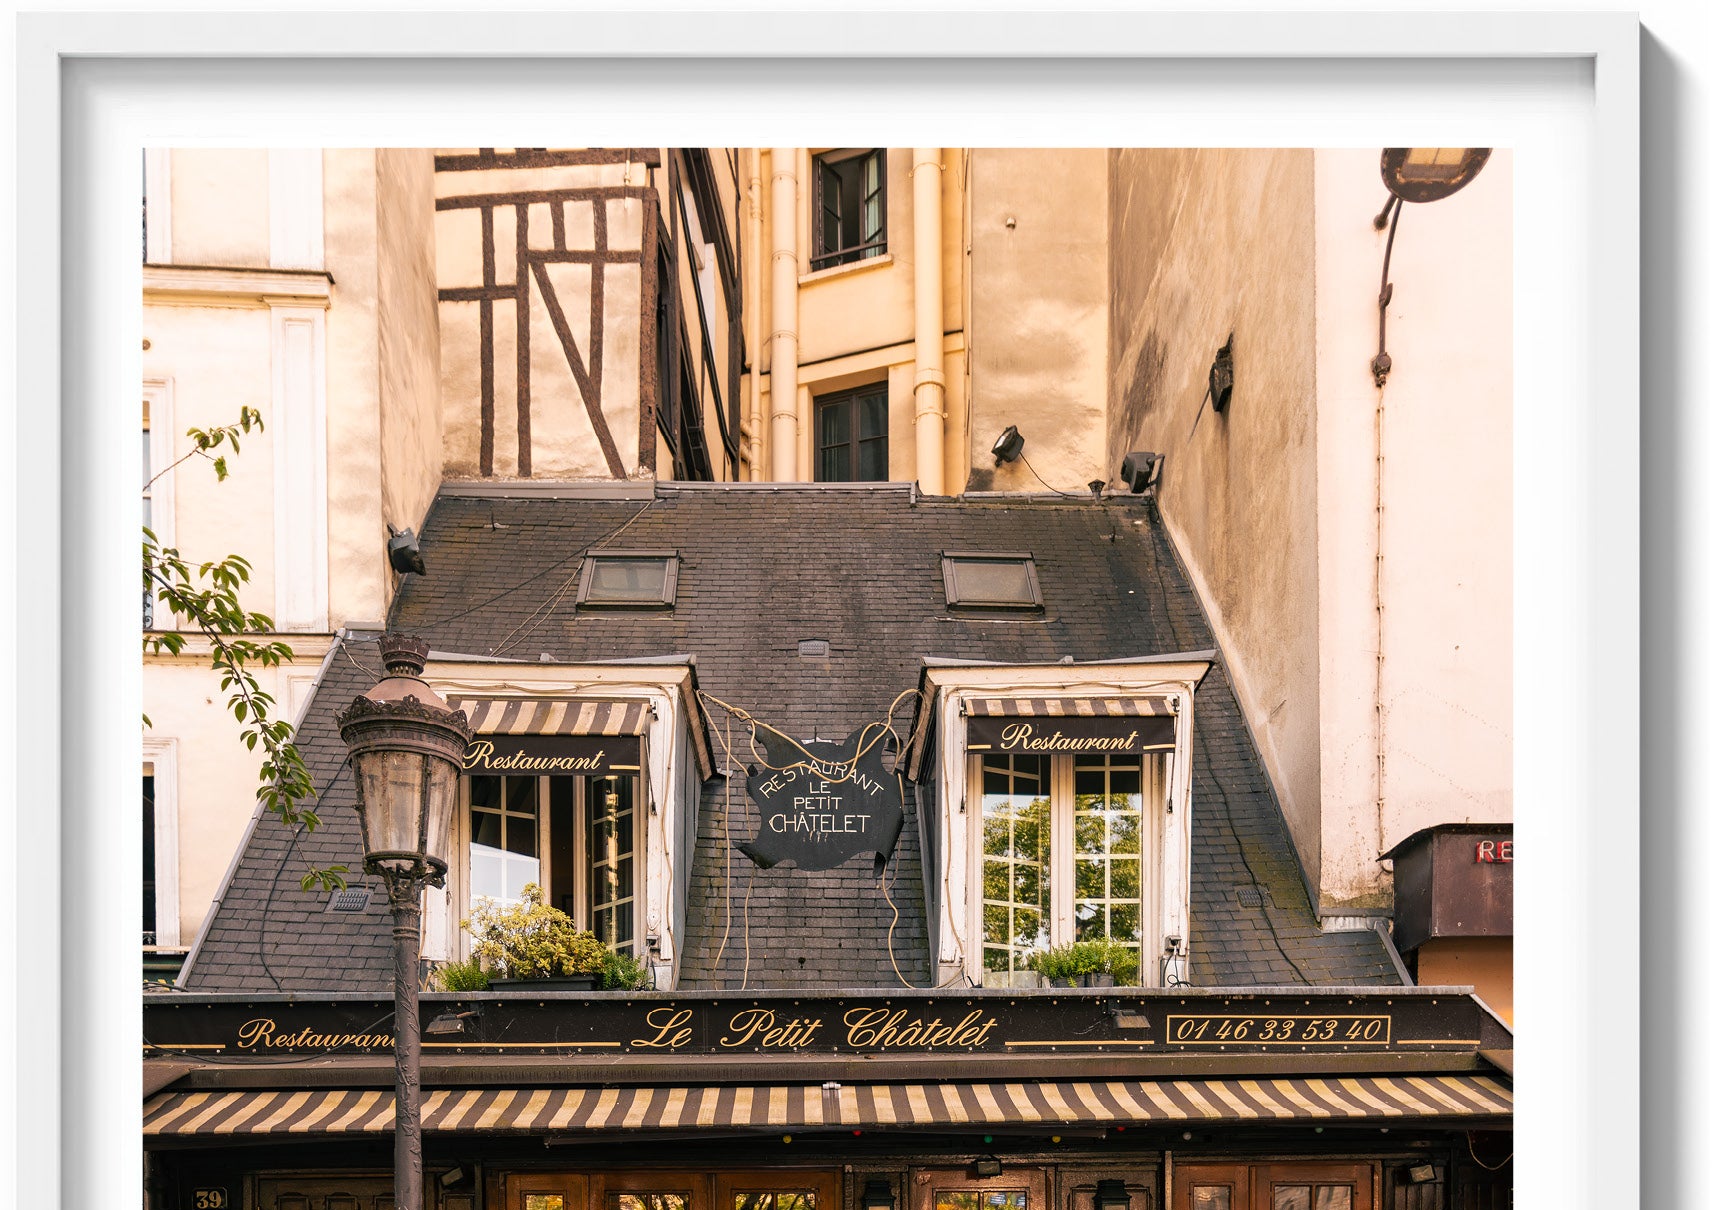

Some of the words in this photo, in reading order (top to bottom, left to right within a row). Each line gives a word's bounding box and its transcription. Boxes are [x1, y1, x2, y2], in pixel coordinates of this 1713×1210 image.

[1000, 723, 1139, 750] Restaurant
[463, 740, 605, 770] Restaurant
[758, 759, 885, 799] RESTAURANT
[809, 781, 831, 794] LE
[768, 812, 871, 833] CHÂTELET
[237, 1018, 395, 1048] Restauran
[630, 1007, 693, 1048] Le
[720, 1008, 823, 1047] Petit
[843, 1007, 998, 1047] Châtelet
[1177, 1019, 1210, 1040] 01
[1215, 1019, 1254, 1040] 46
[1259, 1019, 1295, 1040] 33
[1302, 1019, 1338, 1040] 53
[1345, 1019, 1382, 1040] 40
[196, 1190, 222, 1209] 39
